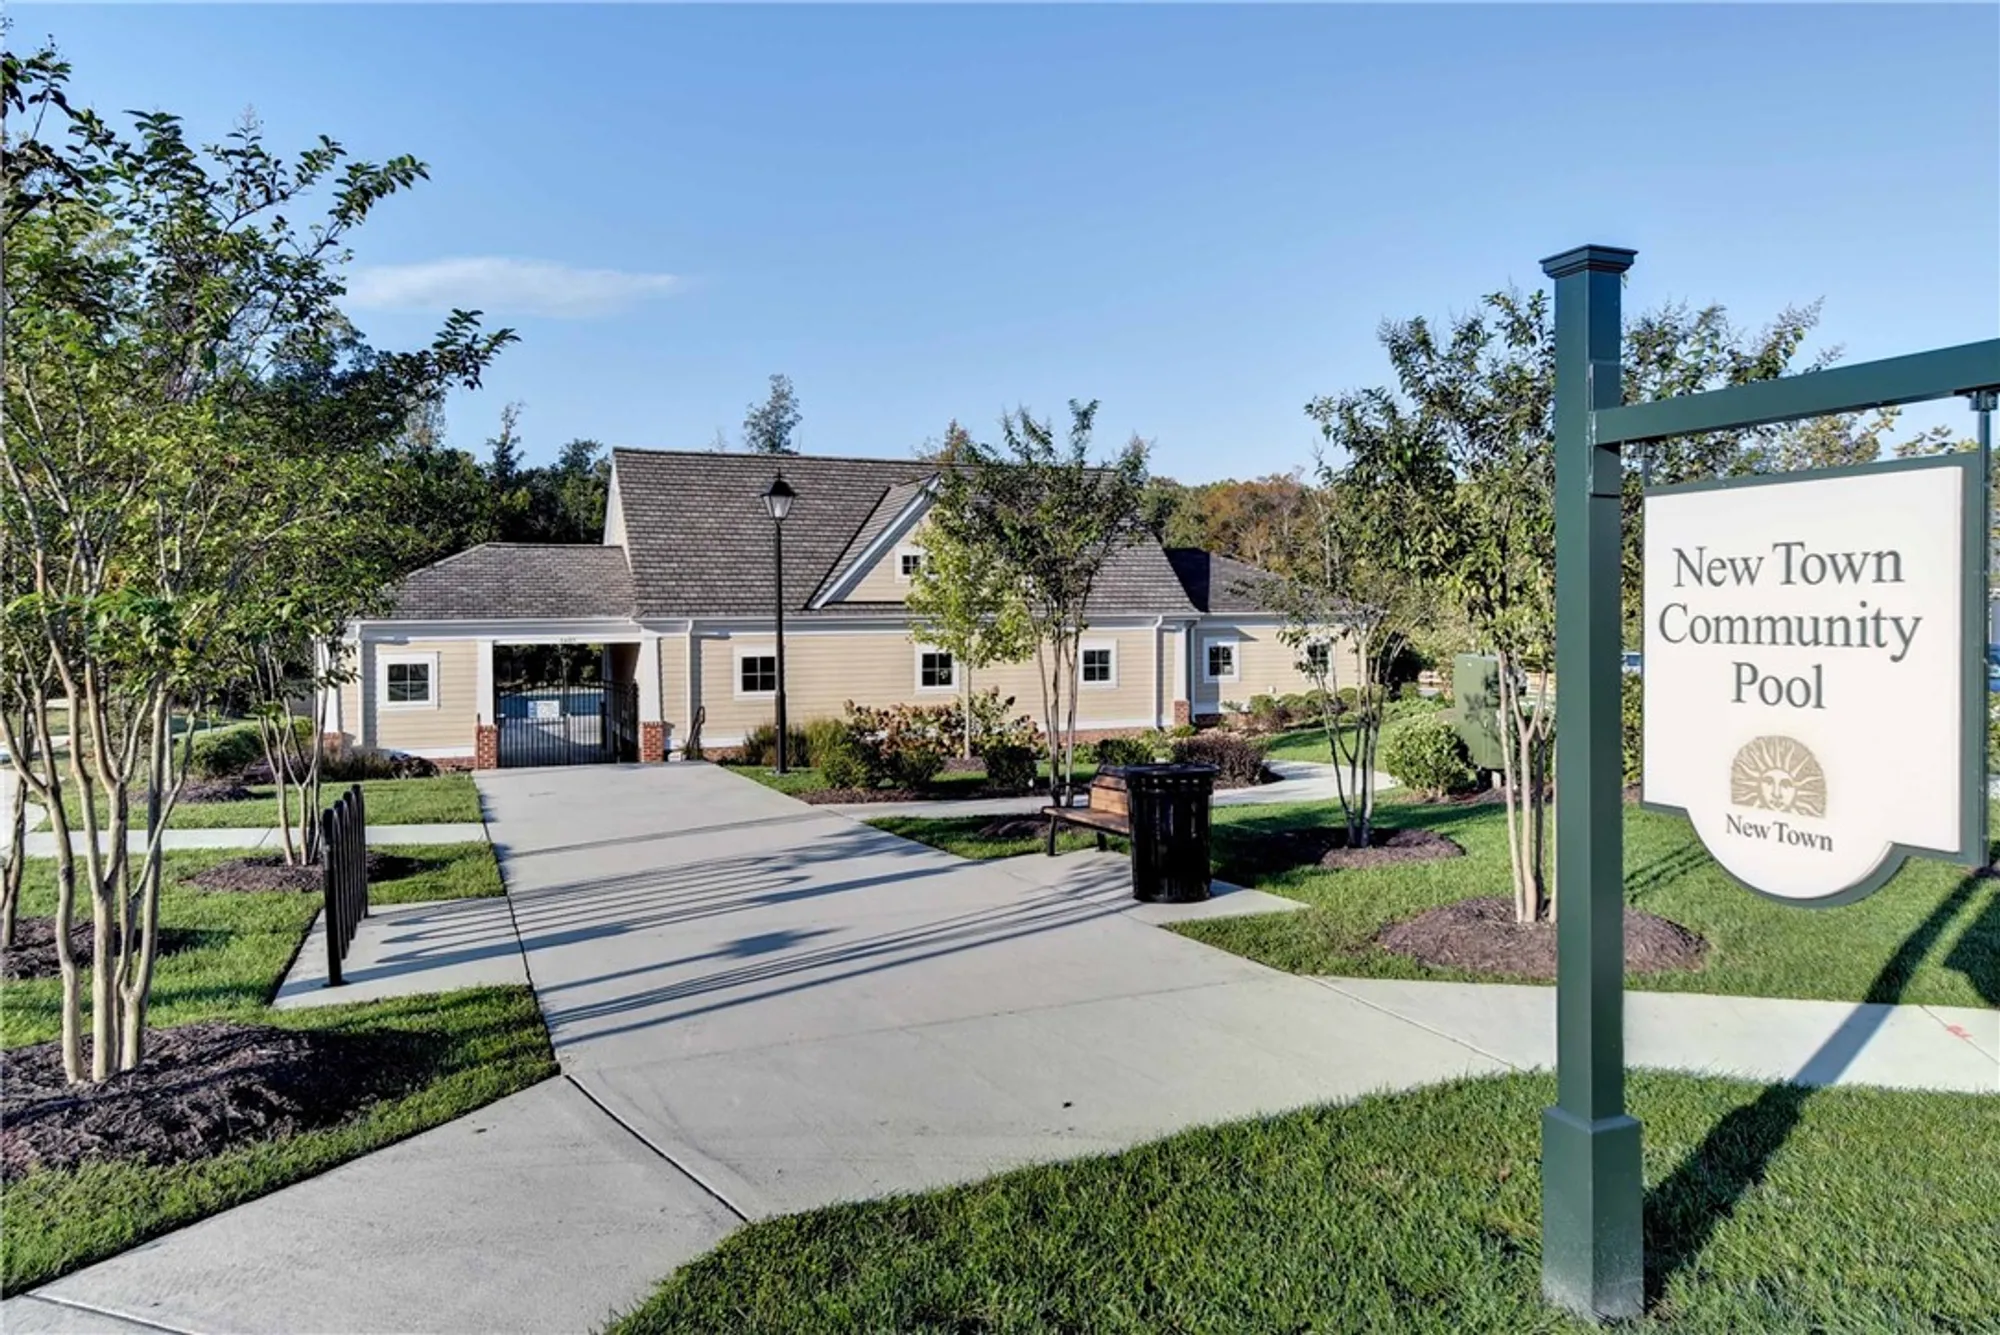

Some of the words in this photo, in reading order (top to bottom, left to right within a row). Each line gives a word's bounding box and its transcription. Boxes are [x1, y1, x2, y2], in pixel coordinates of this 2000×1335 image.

[1672, 546, 1765, 588] New
[1772, 541, 1906, 586] Town
[1658, 601, 1923, 663] Community
[1731, 661, 1827, 709] Pool
[1725, 813, 1771, 840] New
[1773, 821, 1834, 852] Town
